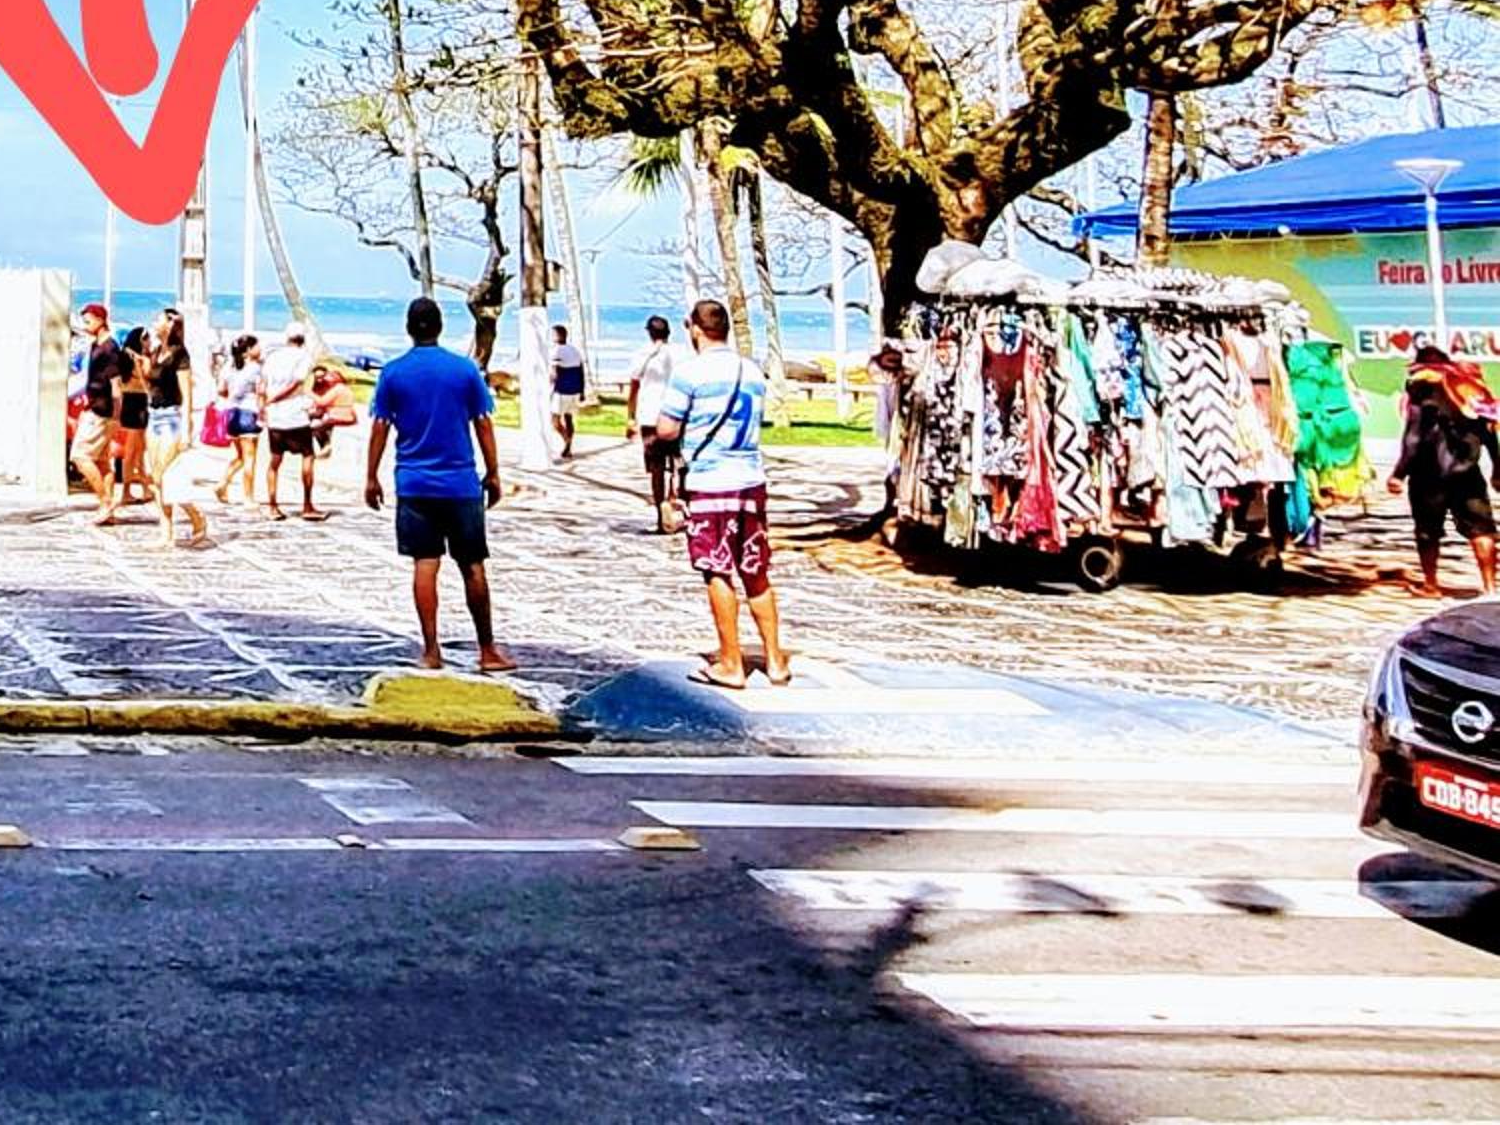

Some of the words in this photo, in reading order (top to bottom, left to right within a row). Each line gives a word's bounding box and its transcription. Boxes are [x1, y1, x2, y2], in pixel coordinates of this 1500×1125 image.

[1378, 259, 1426, 284] Feira
[1359, 330, 1390, 353] EU
[1412, 331, 1500, 356] GARU
